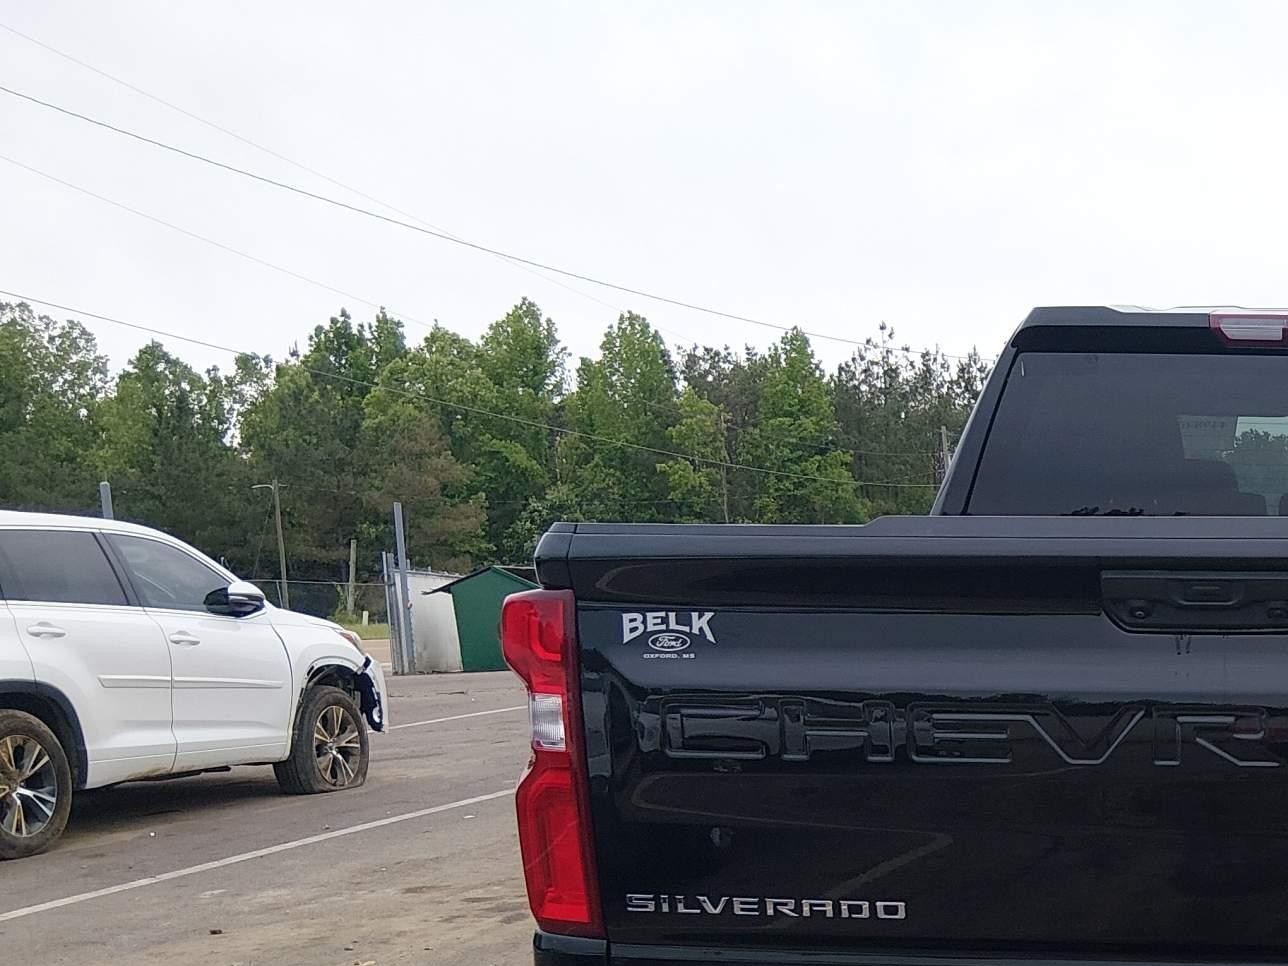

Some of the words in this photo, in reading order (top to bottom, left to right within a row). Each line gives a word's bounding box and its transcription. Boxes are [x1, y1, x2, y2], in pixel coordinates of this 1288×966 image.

[622, 612, 716, 644] BELK
[655, 636, 683, 648] Ford
[626, 894, 907, 920] SILVERADO
